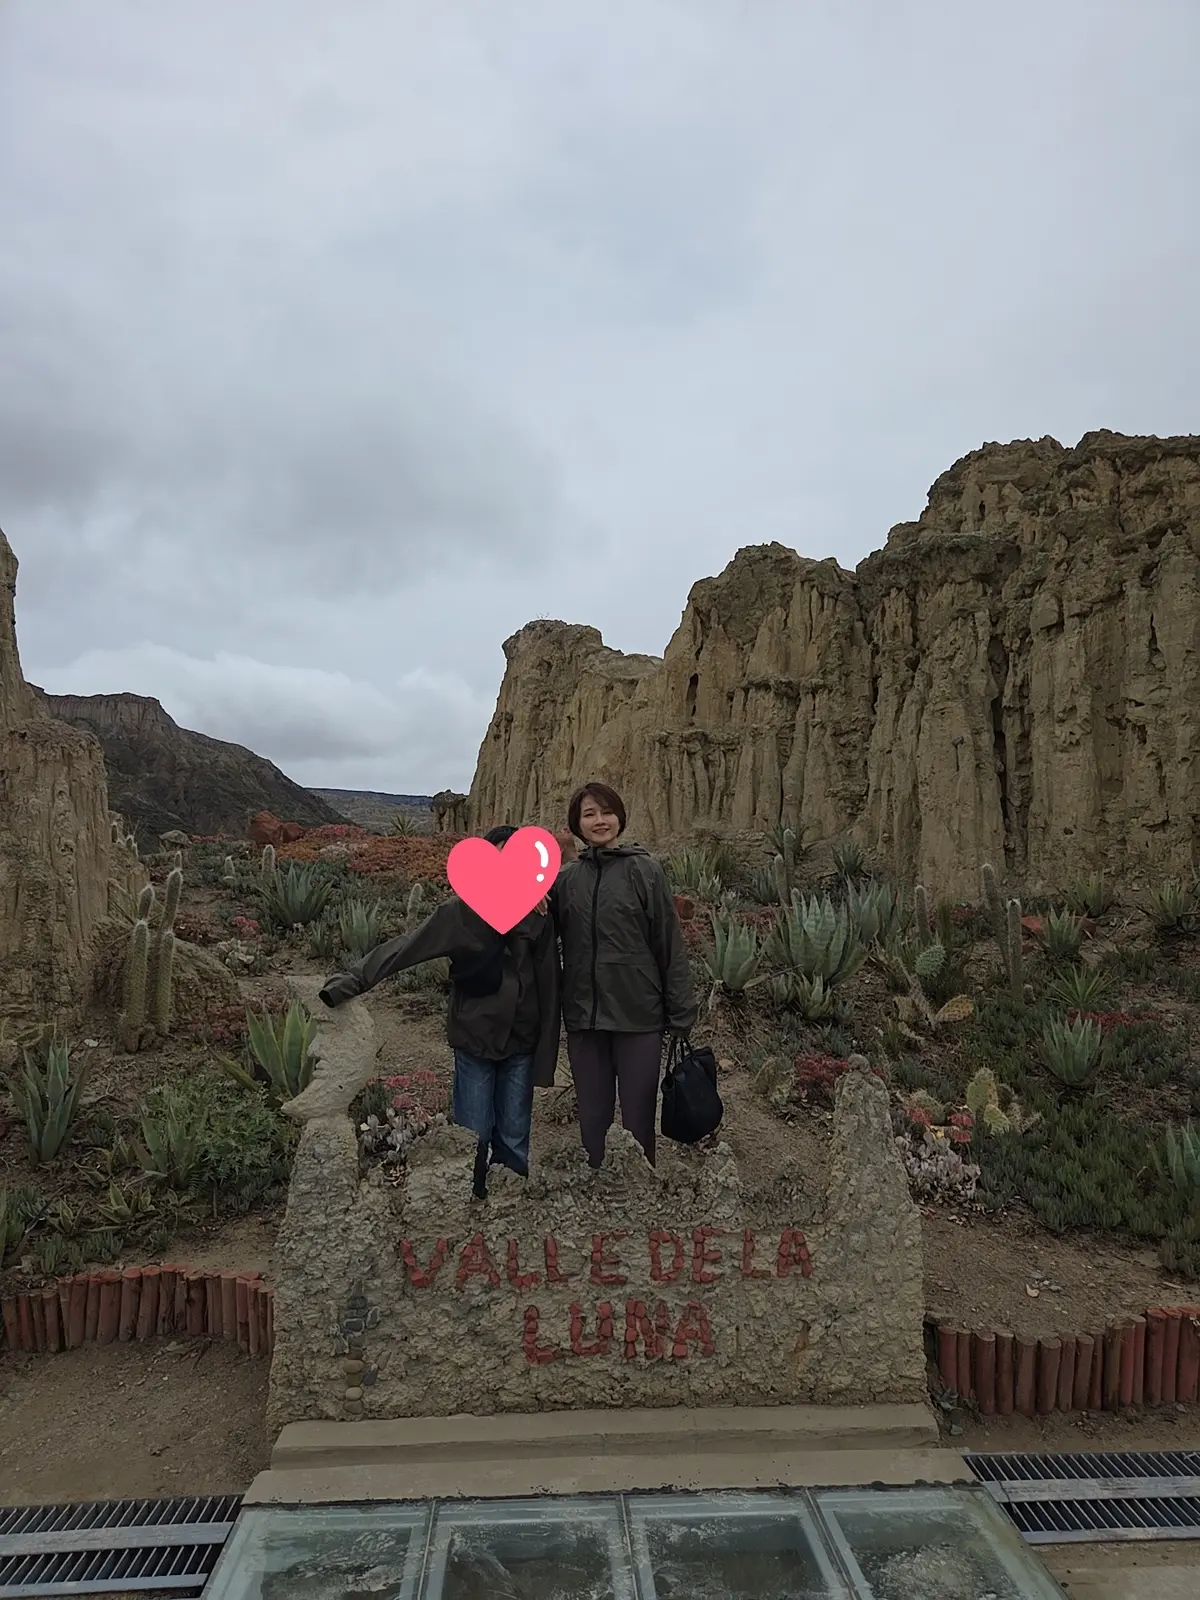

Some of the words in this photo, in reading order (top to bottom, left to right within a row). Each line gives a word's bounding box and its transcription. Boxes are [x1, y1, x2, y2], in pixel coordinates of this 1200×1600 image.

[401, 1230, 629, 1289] VALLE
[650, 1226, 723, 1283] DE
[742, 1228, 814, 1279] LA
[524, 1298, 716, 1364] LUNA
